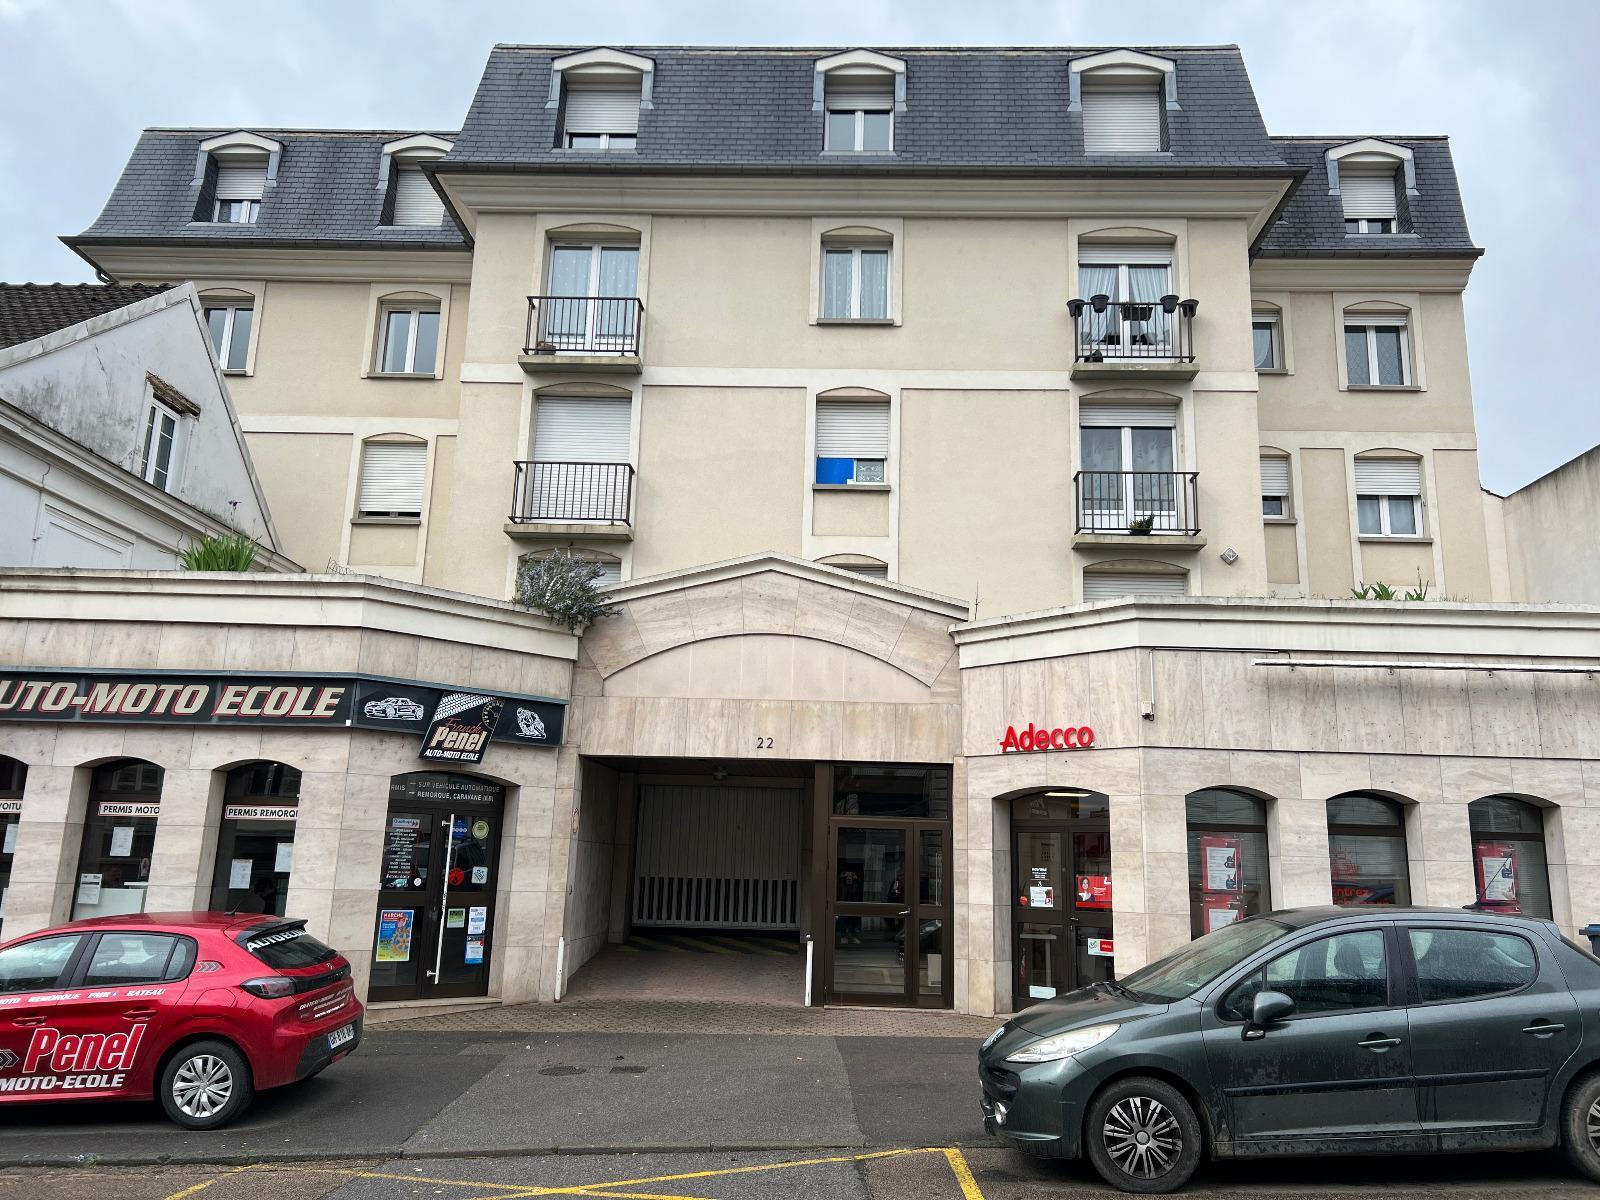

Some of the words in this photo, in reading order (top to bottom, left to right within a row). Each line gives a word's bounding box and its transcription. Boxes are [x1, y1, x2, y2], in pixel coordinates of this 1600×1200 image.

[213, 685, 345, 718] ECOLE
[446, 717, 483, 734] Franck
[428, 726, 488, 752] Penel
[756, 737, 774, 749] 22
[1000, 722, 1094, 752] Adecco
[424, 748, 460, 759] AUTO-MOTO
[460, 751, 480, 761] ECOLE
[103, 805, 133, 814] PERMIS
[228, 808, 258, 817] PERMIS
[28, 993, 82, 1003] REMORQUE
[126, 988, 166, 997] BATEAU
[22, 1024, 147, 1073] Penel
